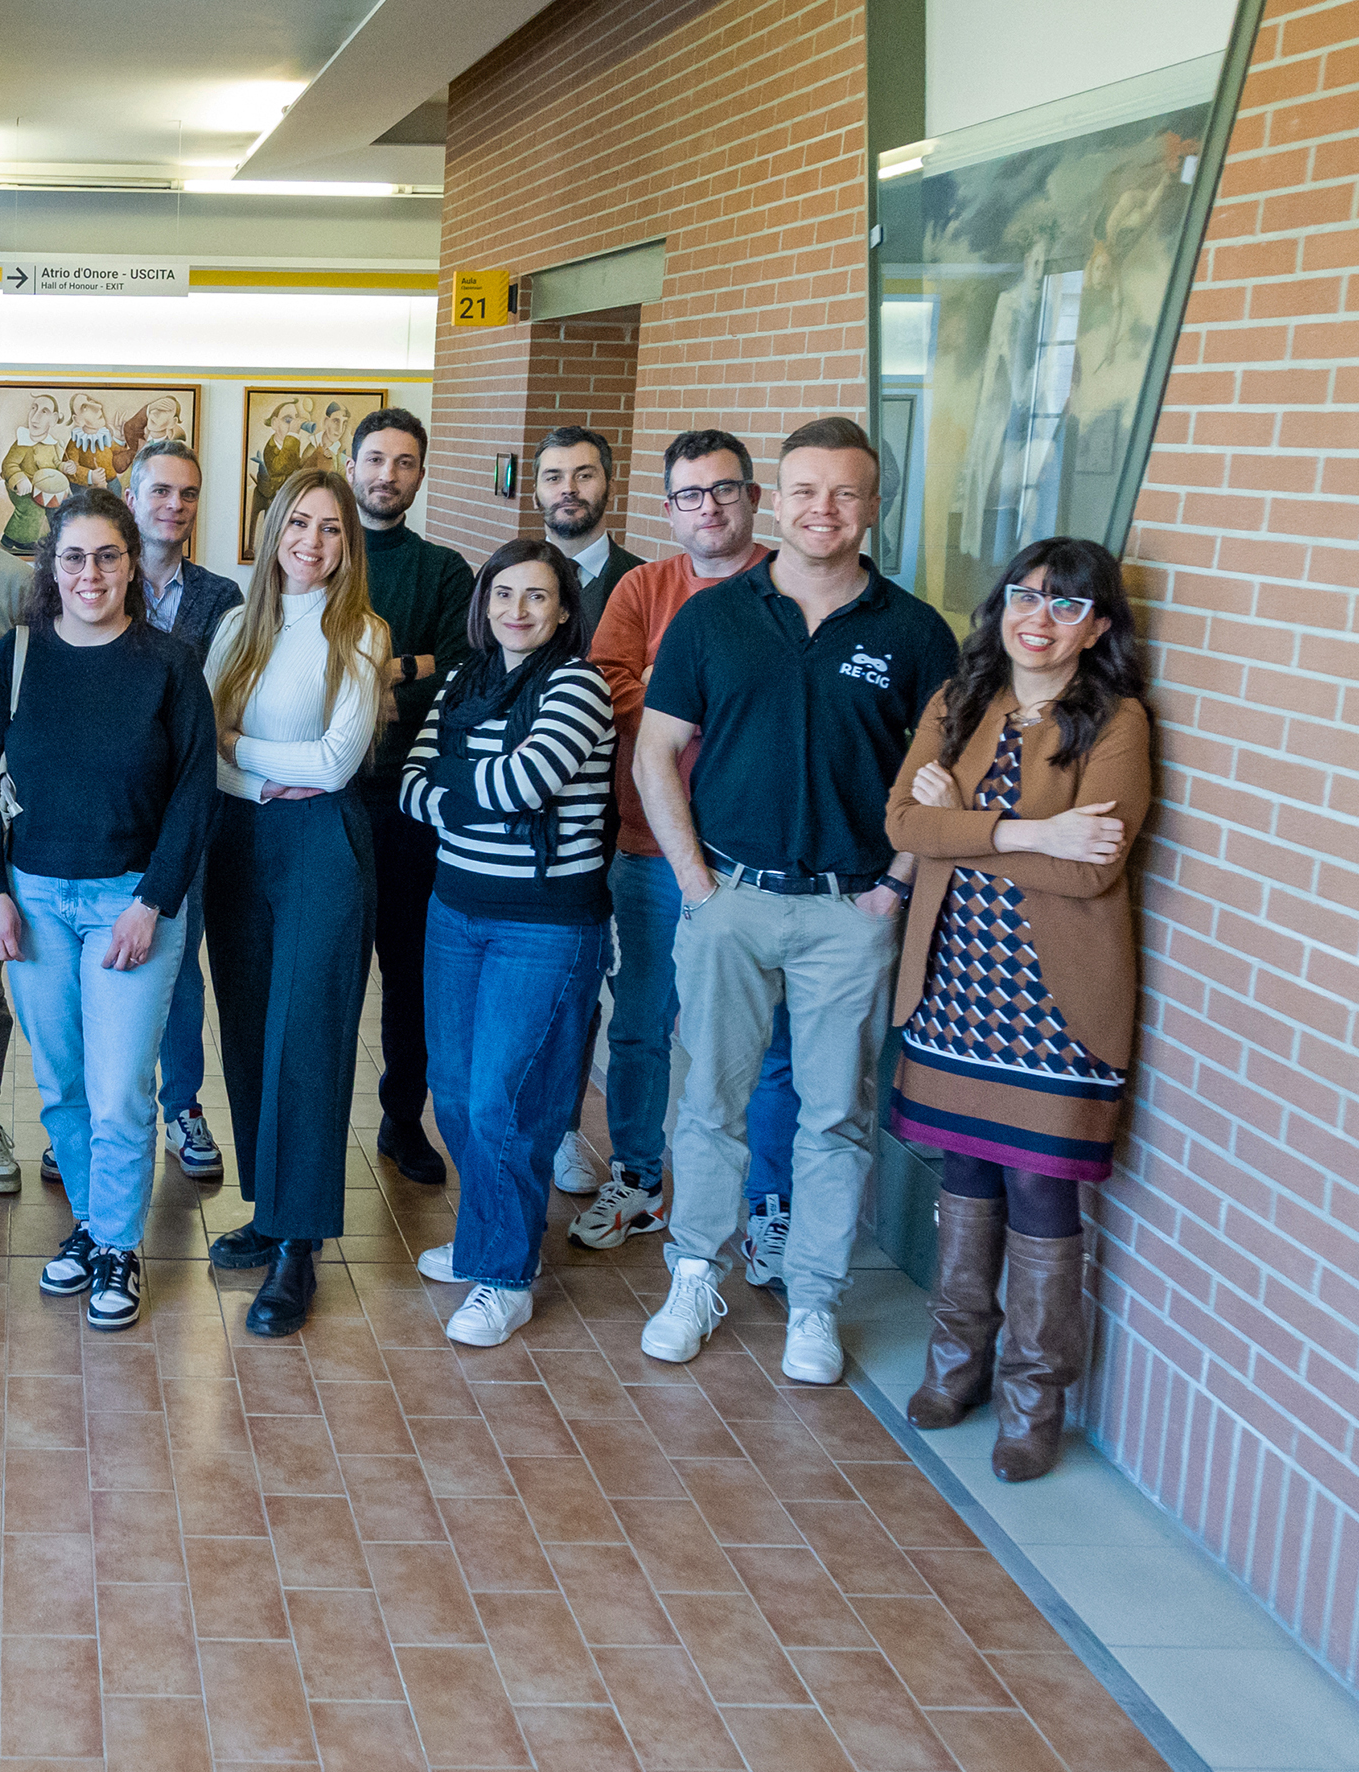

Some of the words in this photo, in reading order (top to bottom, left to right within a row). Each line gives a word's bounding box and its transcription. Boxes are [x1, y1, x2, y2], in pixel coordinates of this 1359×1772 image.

[41, 267, 70, 279] Atrio
[73, 267, 119, 279] d'Onore
[130, 268, 176, 280] USCITA
[41, 281, 57, 290] Hall
[58, 281, 68, 290] of
[69, 282, 98, 290] Honour
[105, 282, 125, 291] EXIT
[461, 277, 477, 285] Aula
[459, 297, 486, 319] 21
